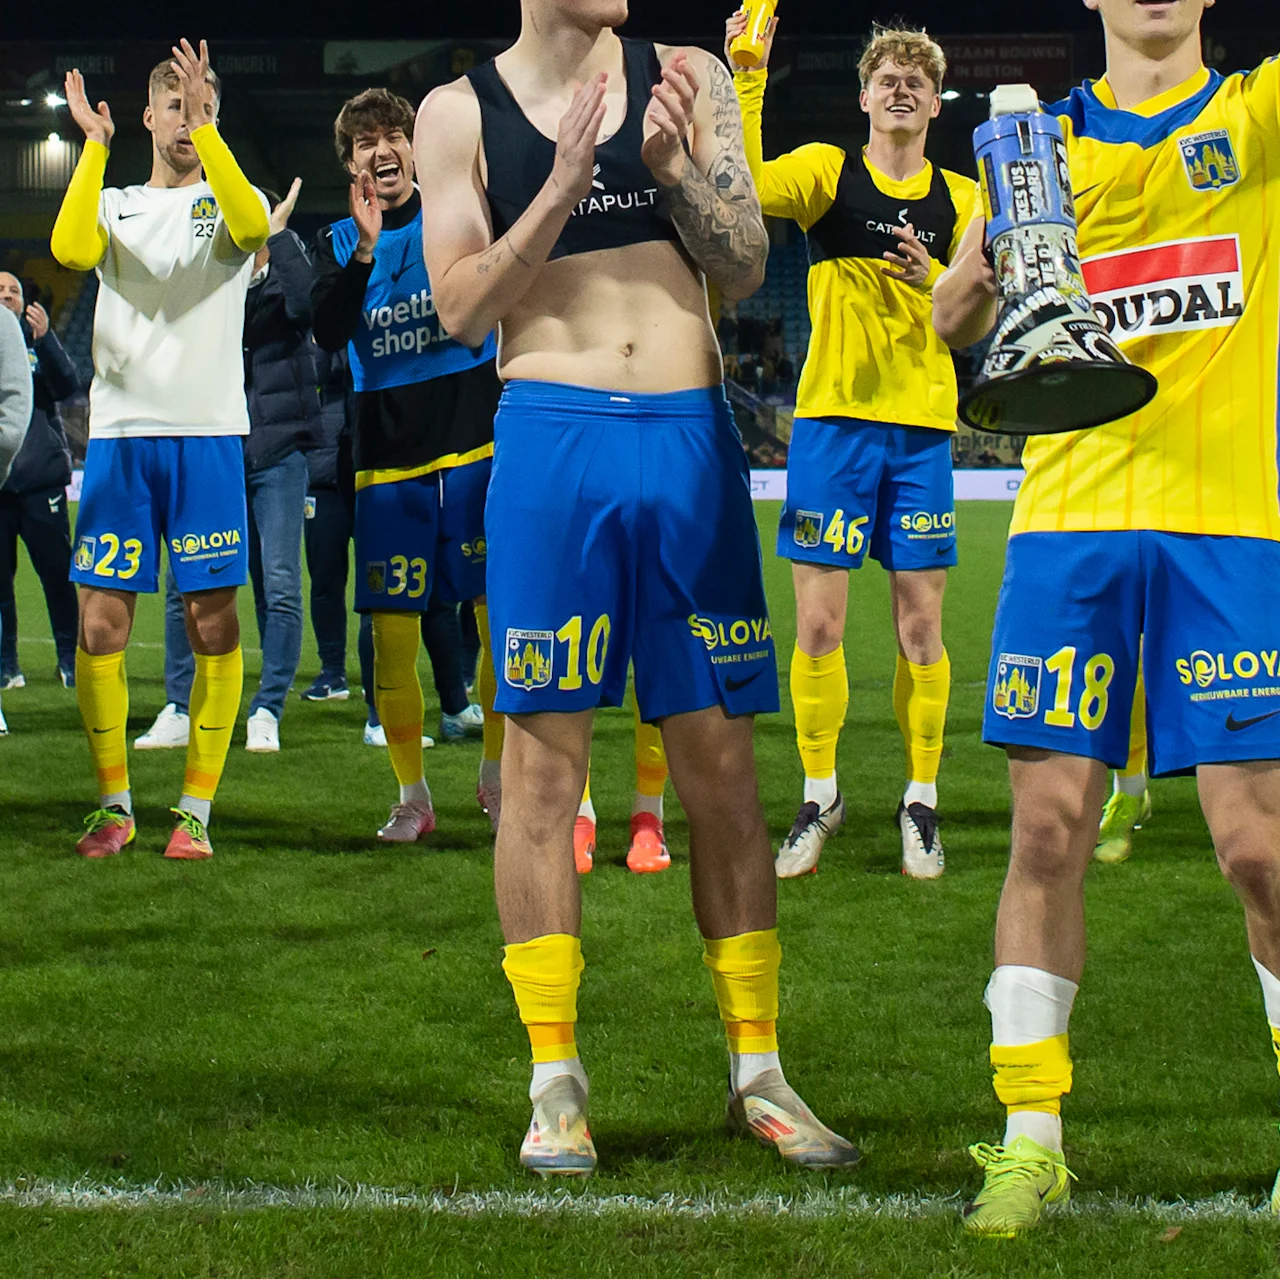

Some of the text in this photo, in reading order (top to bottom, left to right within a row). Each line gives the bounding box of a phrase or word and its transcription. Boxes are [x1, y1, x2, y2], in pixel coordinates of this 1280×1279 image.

[1192, 130, 1227, 142] WESTERLO
[571, 188, 657, 217] TAPULT
[194, 223, 215, 238] 23
[865, 220, 936, 243] CATULT
[363, 289, 436, 331] voetb
[1092, 281, 1243, 335] OUDAL
[171, 529, 241, 554] SOLOYA
[823, 509, 869, 555] 46
[901, 511, 955, 533] SOLO
[94, 533, 142, 579] 23
[387, 555, 427, 598] 33
[555, 613, 611, 690] 10
[1044, 646, 1114, 731] 18
